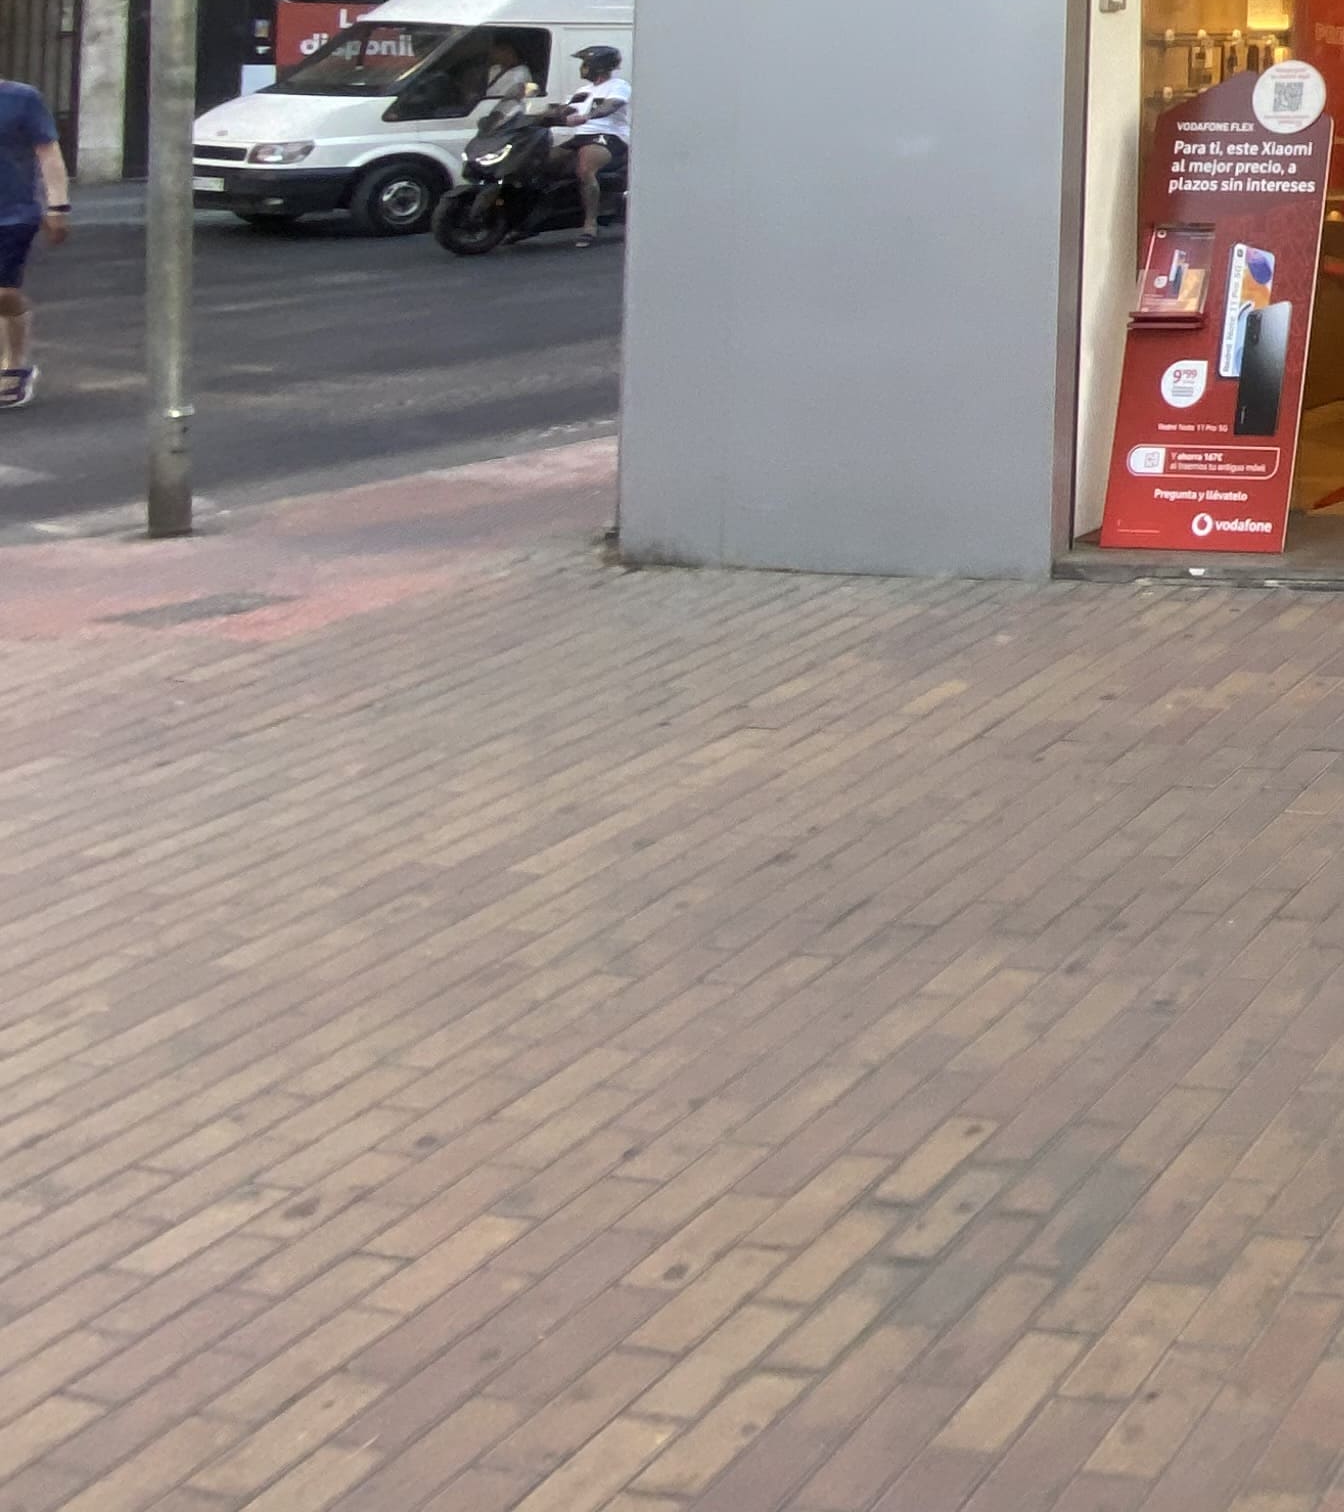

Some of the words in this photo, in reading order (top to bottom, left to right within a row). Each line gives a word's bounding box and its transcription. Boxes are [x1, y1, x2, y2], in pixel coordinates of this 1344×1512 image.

[1177, 122, 1230, 132] VODAFONE
[1231, 122, 1255, 133] FLEX
[1174, 141, 1207, 155] Para
[1209, 141, 1223, 156] ti,
[1227, 144, 1259, 156] este
[1261, 141, 1313, 157] Xiaomi
[1171, 159, 1186, 173] al
[1189, 160, 1233, 176] mejor
[1235, 160, 1285, 177] precio,
[1287, 163, 1297, 175] a
[1168, 177, 1218, 194] plazos
[1221, 179, 1243, 191] sin
[1246, 179, 1316, 193] intereses
[1154, 489, 1197, 501] Pregunta
[1199, 492, 1205, 502] y
[1206, 490, 1248, 502] llévatelo
[1215, 519, 1273, 533] vodafone
